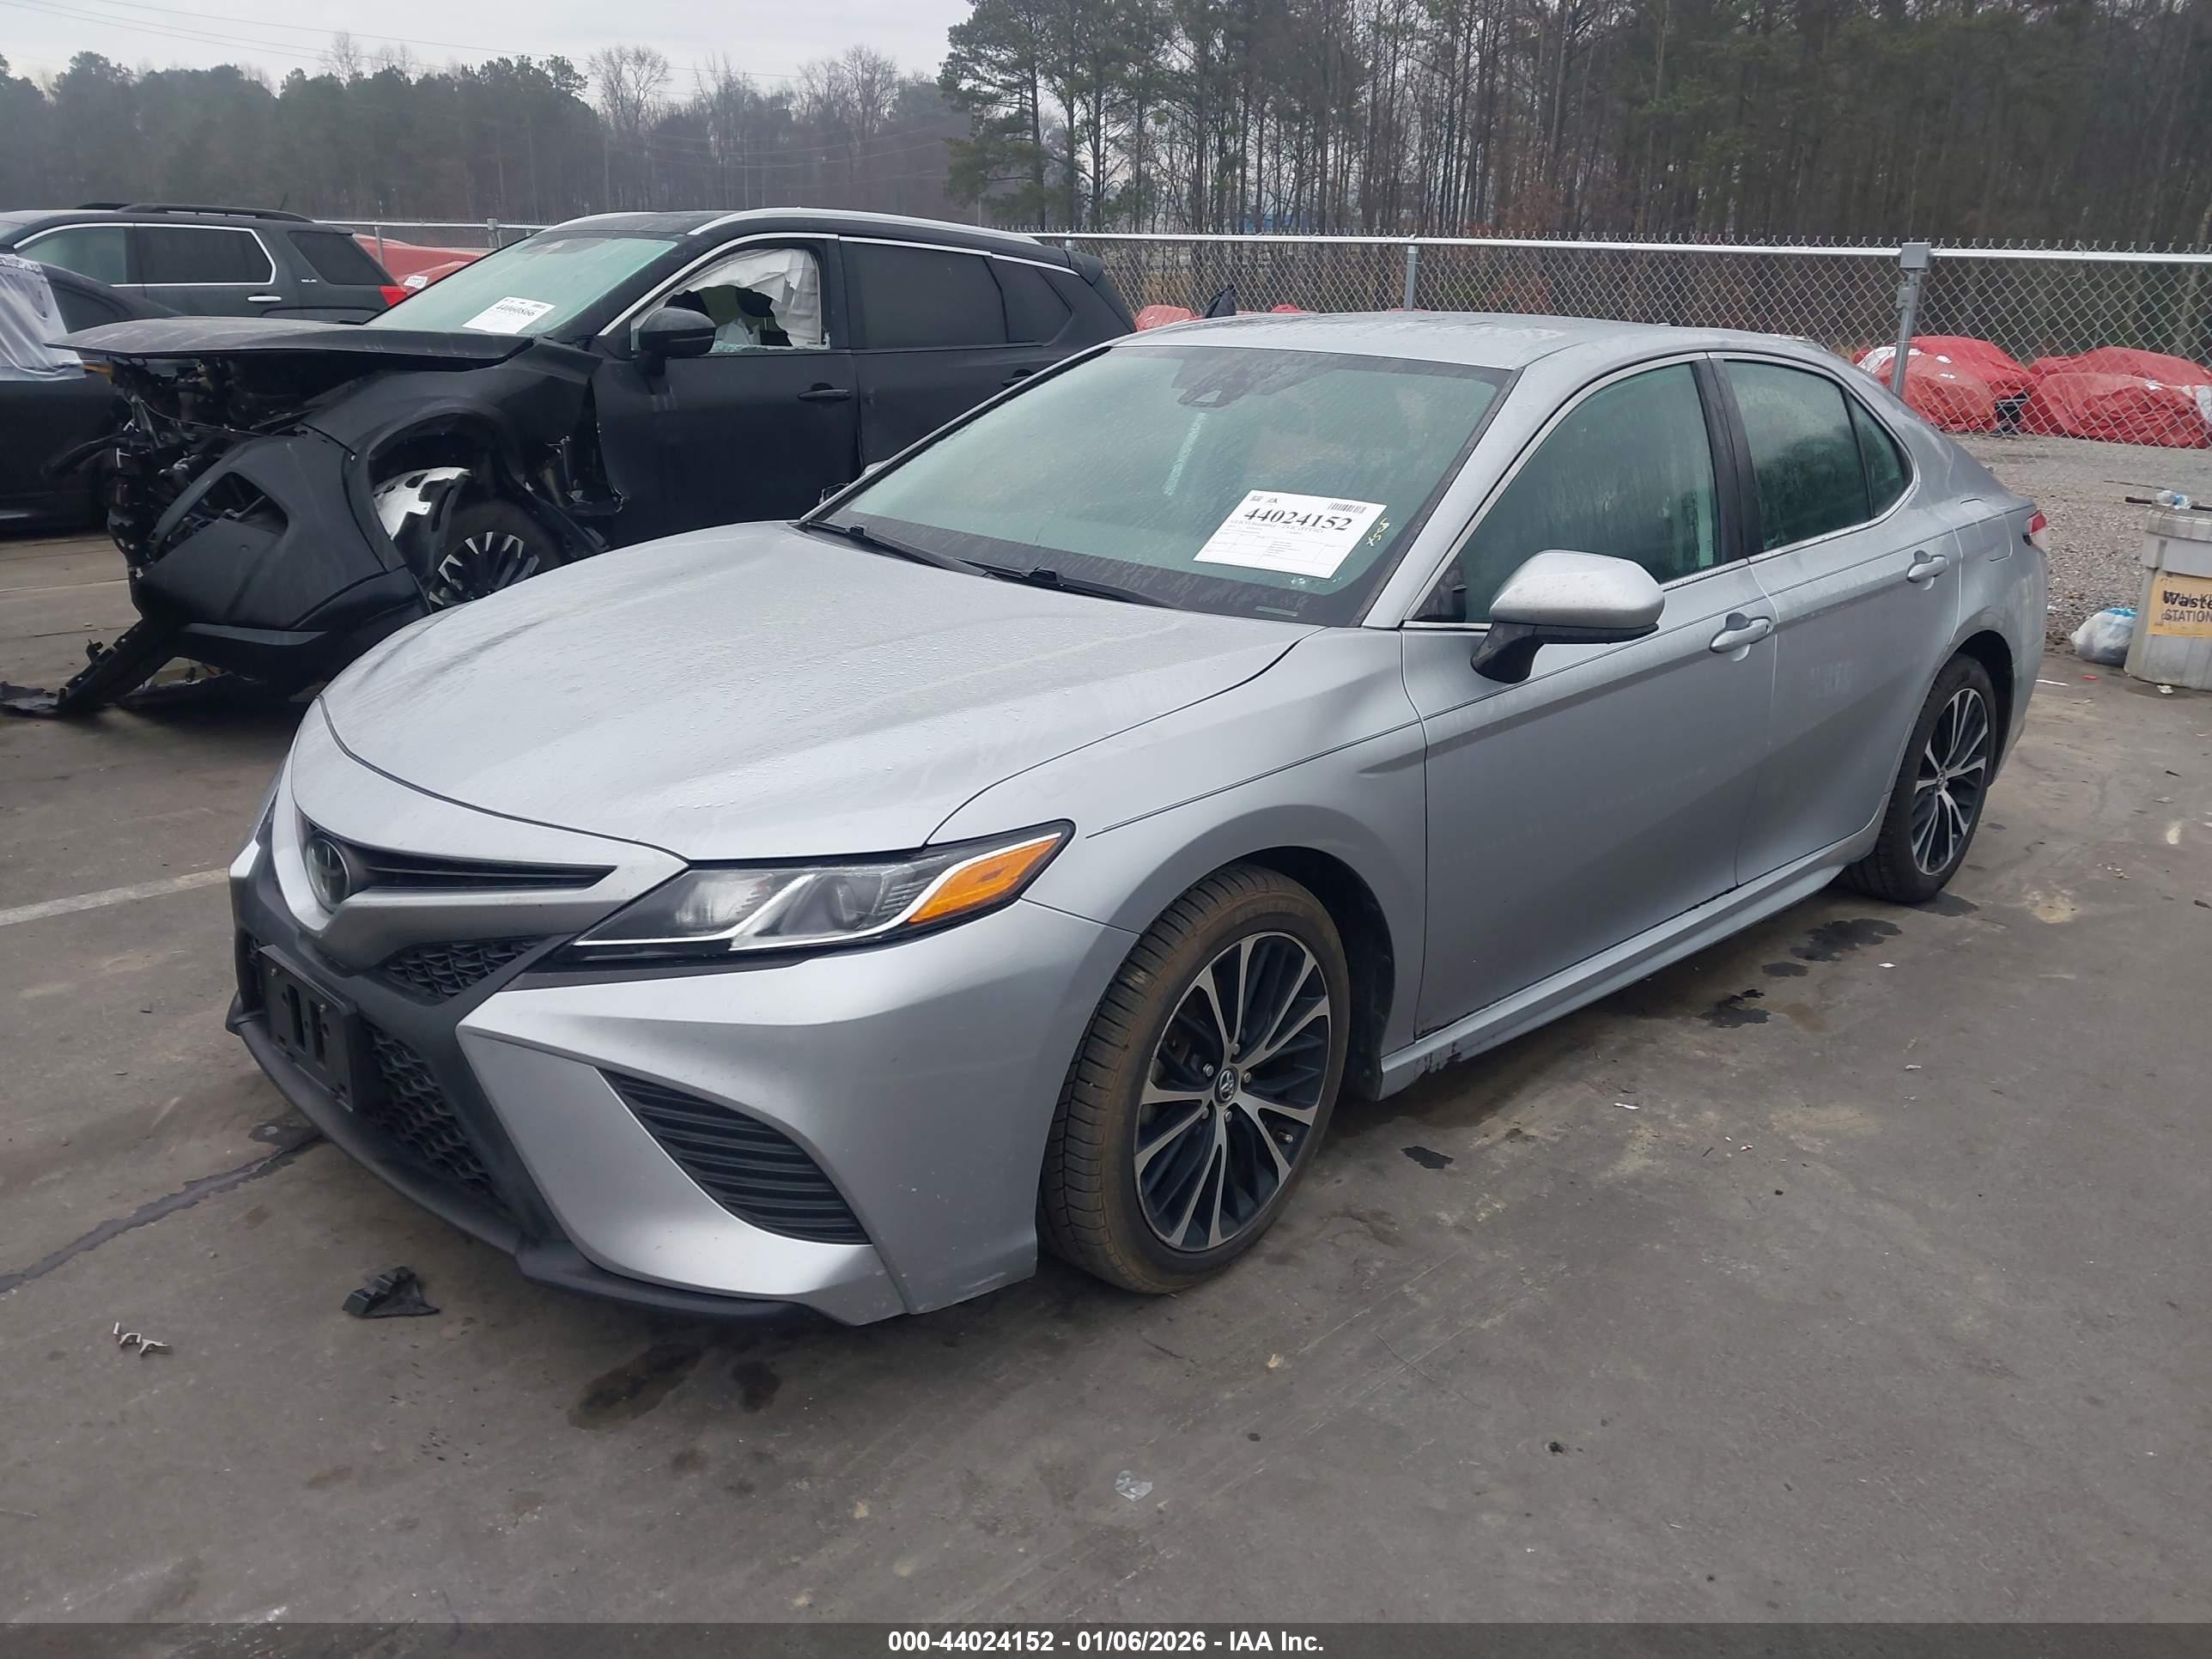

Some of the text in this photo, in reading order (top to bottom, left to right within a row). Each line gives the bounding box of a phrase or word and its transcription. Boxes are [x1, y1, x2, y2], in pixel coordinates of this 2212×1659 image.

[1244, 508, 1352, 531] 44024152
[2163, 590, 2212, 610] Waste
[2161, 609, 2212, 623] STATION
